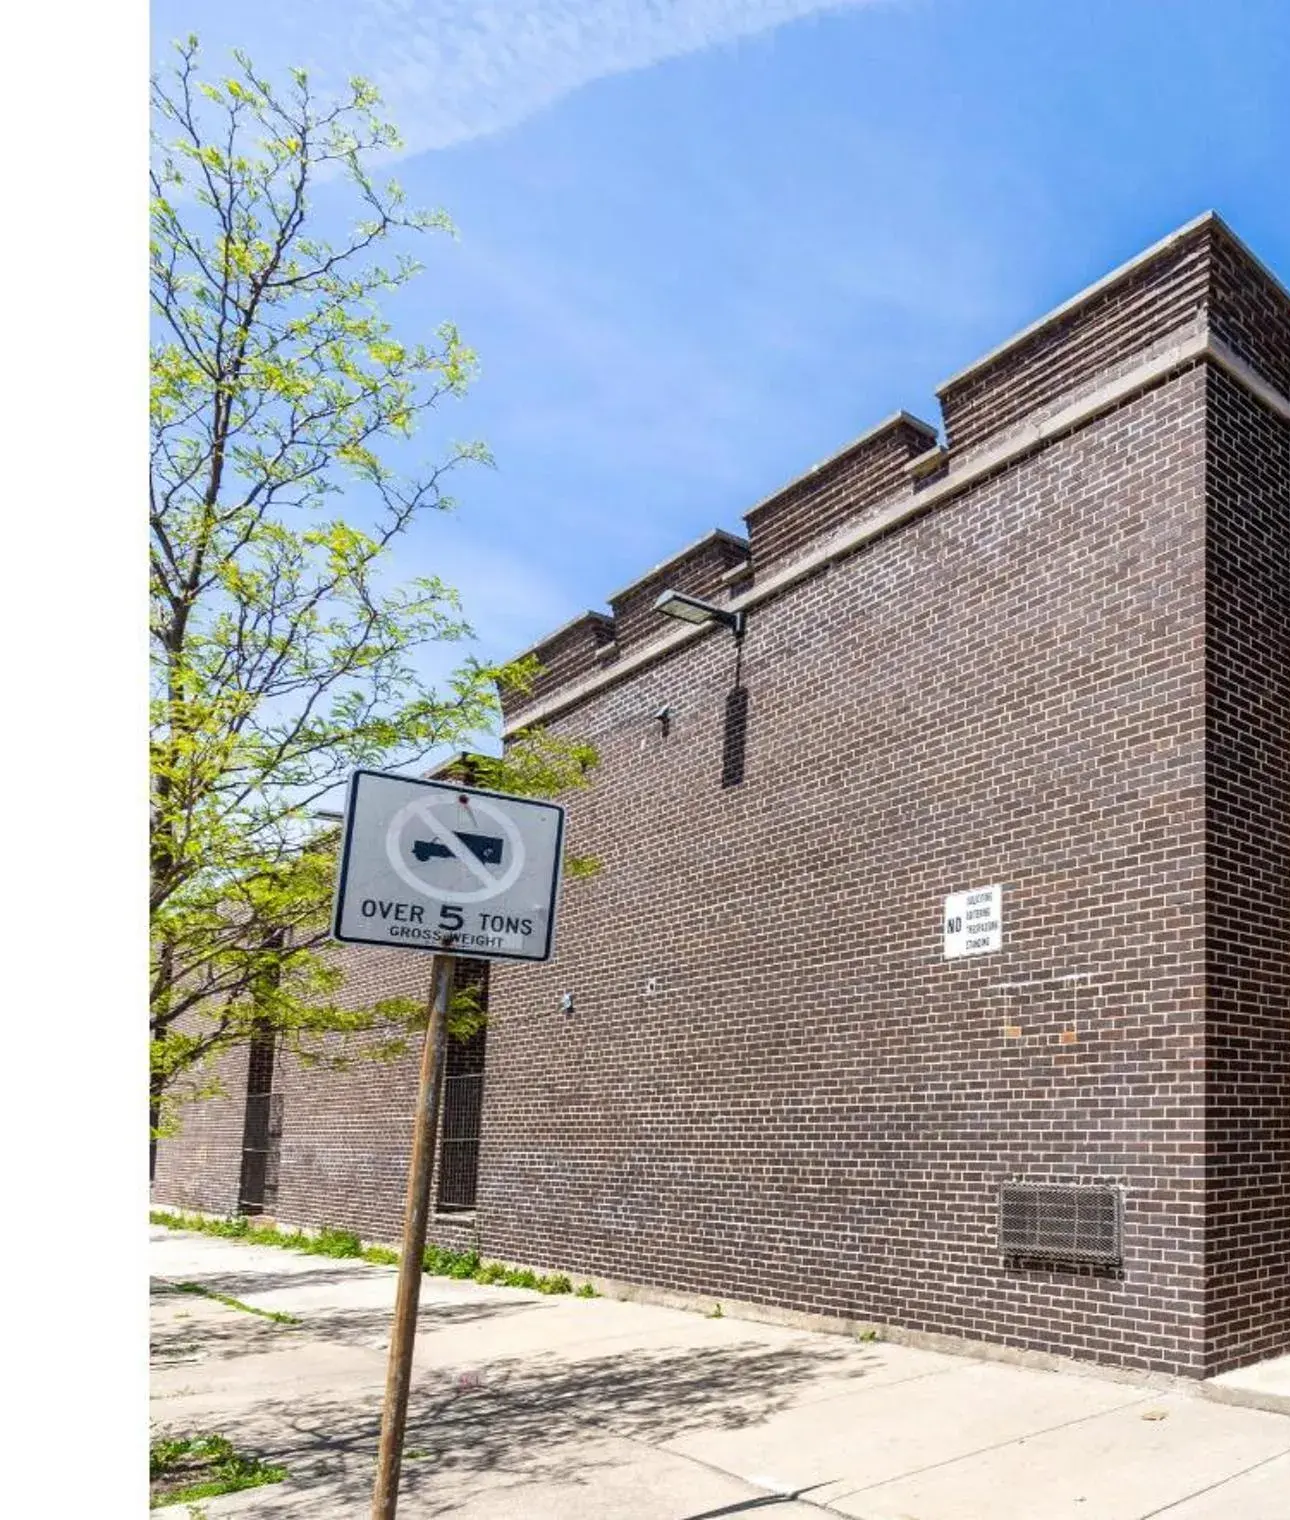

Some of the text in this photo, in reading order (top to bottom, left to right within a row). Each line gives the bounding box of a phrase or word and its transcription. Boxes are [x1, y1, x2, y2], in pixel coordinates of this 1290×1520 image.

[361, 899, 533, 936] OVER 5 TONS
[947, 916, 961, 934] NO
[389, 925, 504, 948] GROSS WEIGHT
